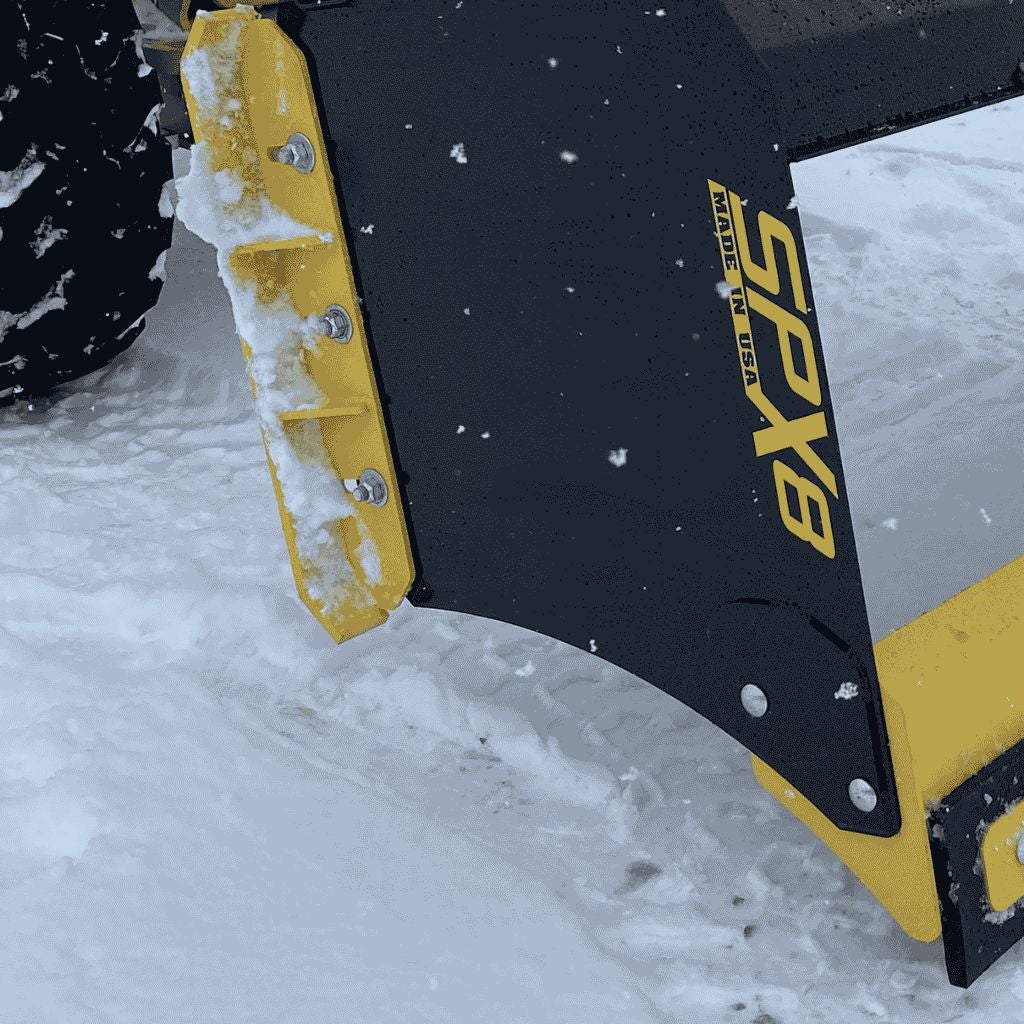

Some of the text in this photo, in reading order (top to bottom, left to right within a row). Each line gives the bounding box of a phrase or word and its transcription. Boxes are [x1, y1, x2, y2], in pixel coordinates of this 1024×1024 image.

[712, 191, 758, 386] MADE IN USA
[728, 189, 839, 560] SPX8
